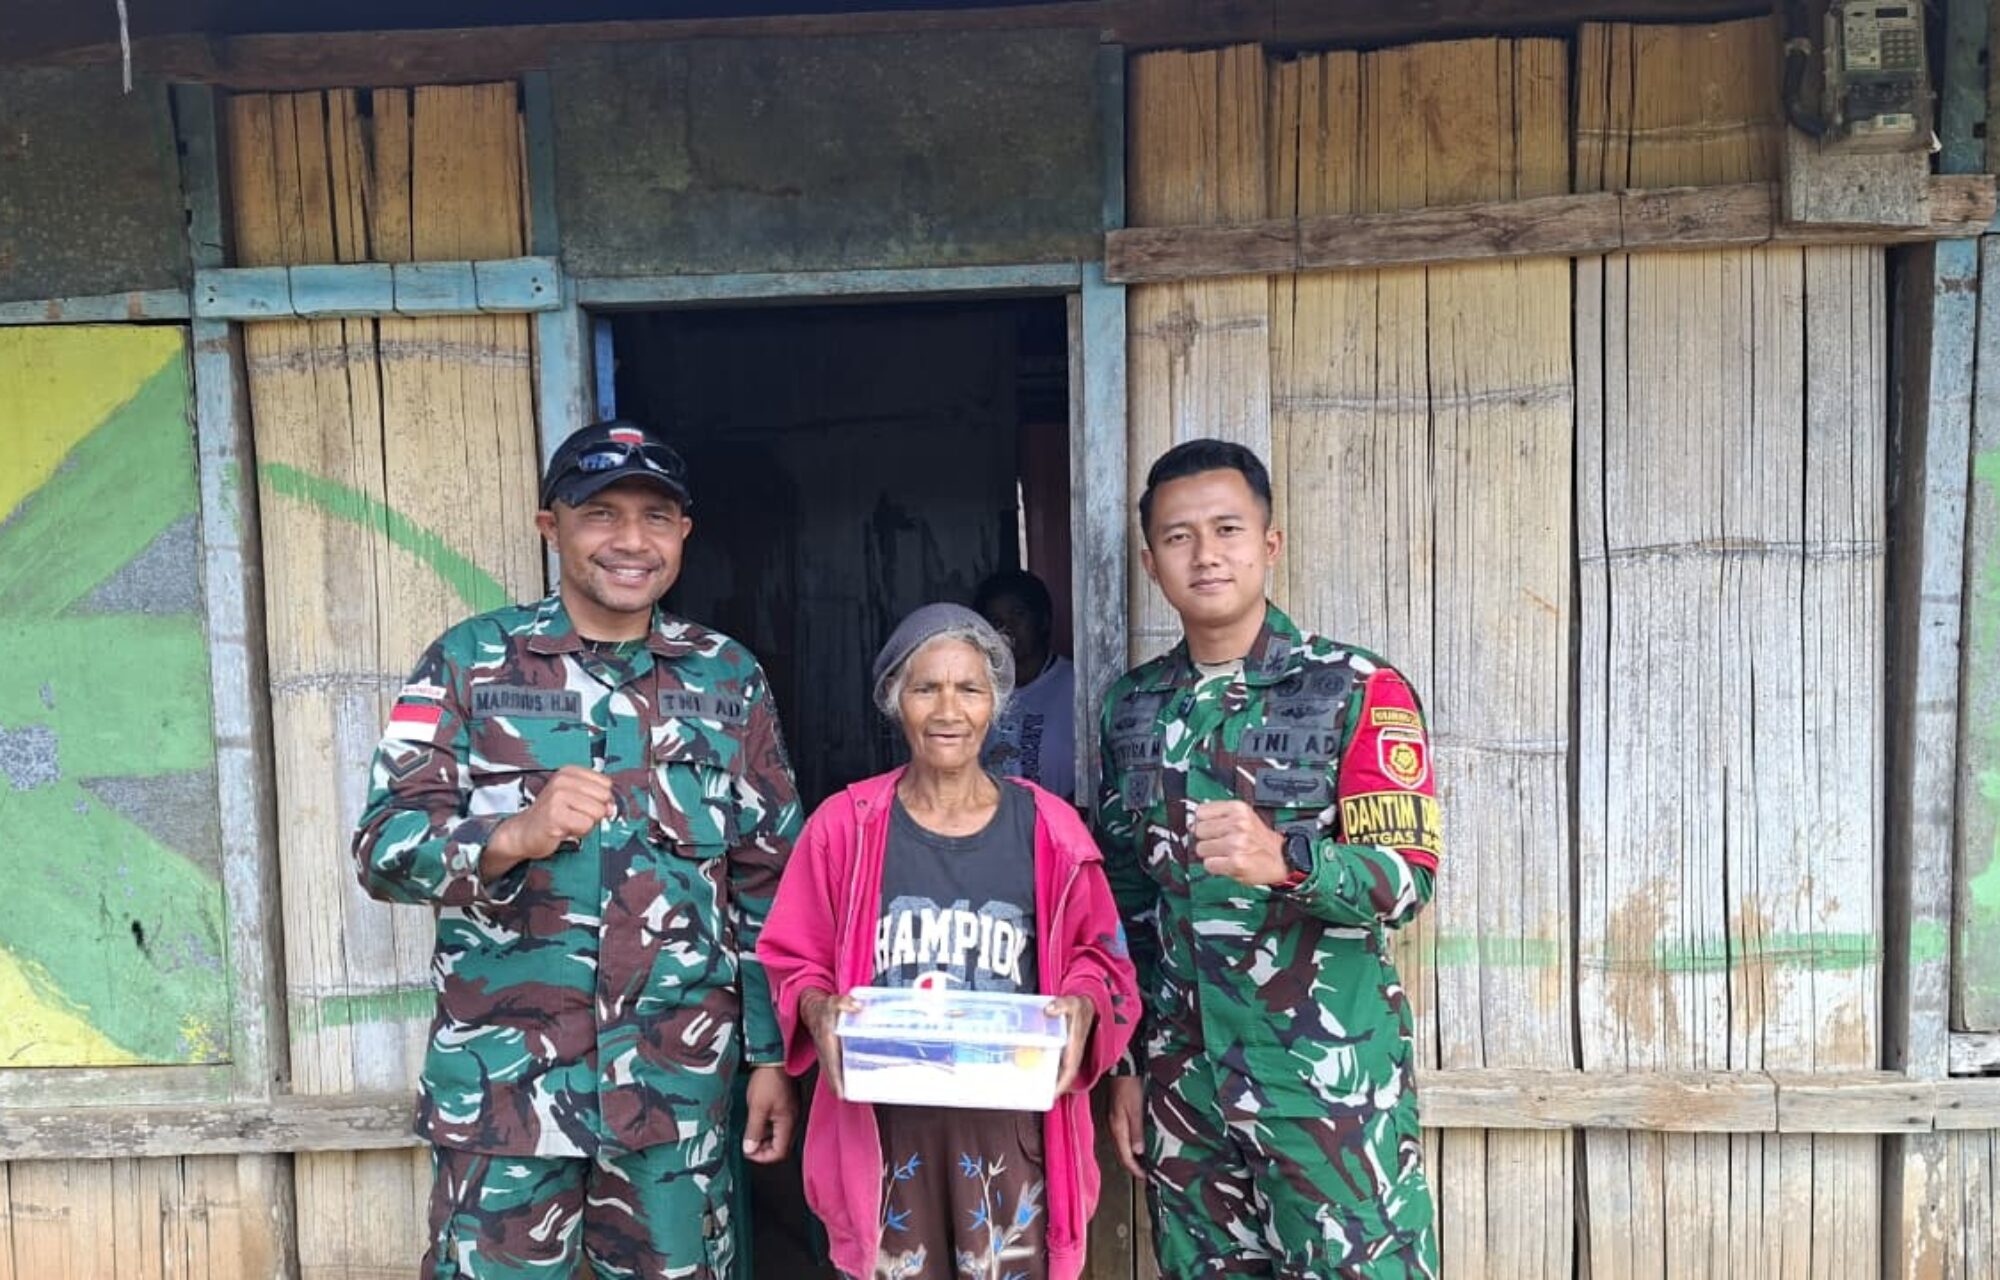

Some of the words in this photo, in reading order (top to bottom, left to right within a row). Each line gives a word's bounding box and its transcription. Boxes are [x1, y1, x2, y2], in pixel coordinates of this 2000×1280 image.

[663, 693, 700, 712] TNI
[715, 698, 741, 717] AD
[1253, 733, 1289, 752] TNI
[1304, 734, 1337, 754] AD
[1345, 796, 1418, 835] DANTIM
